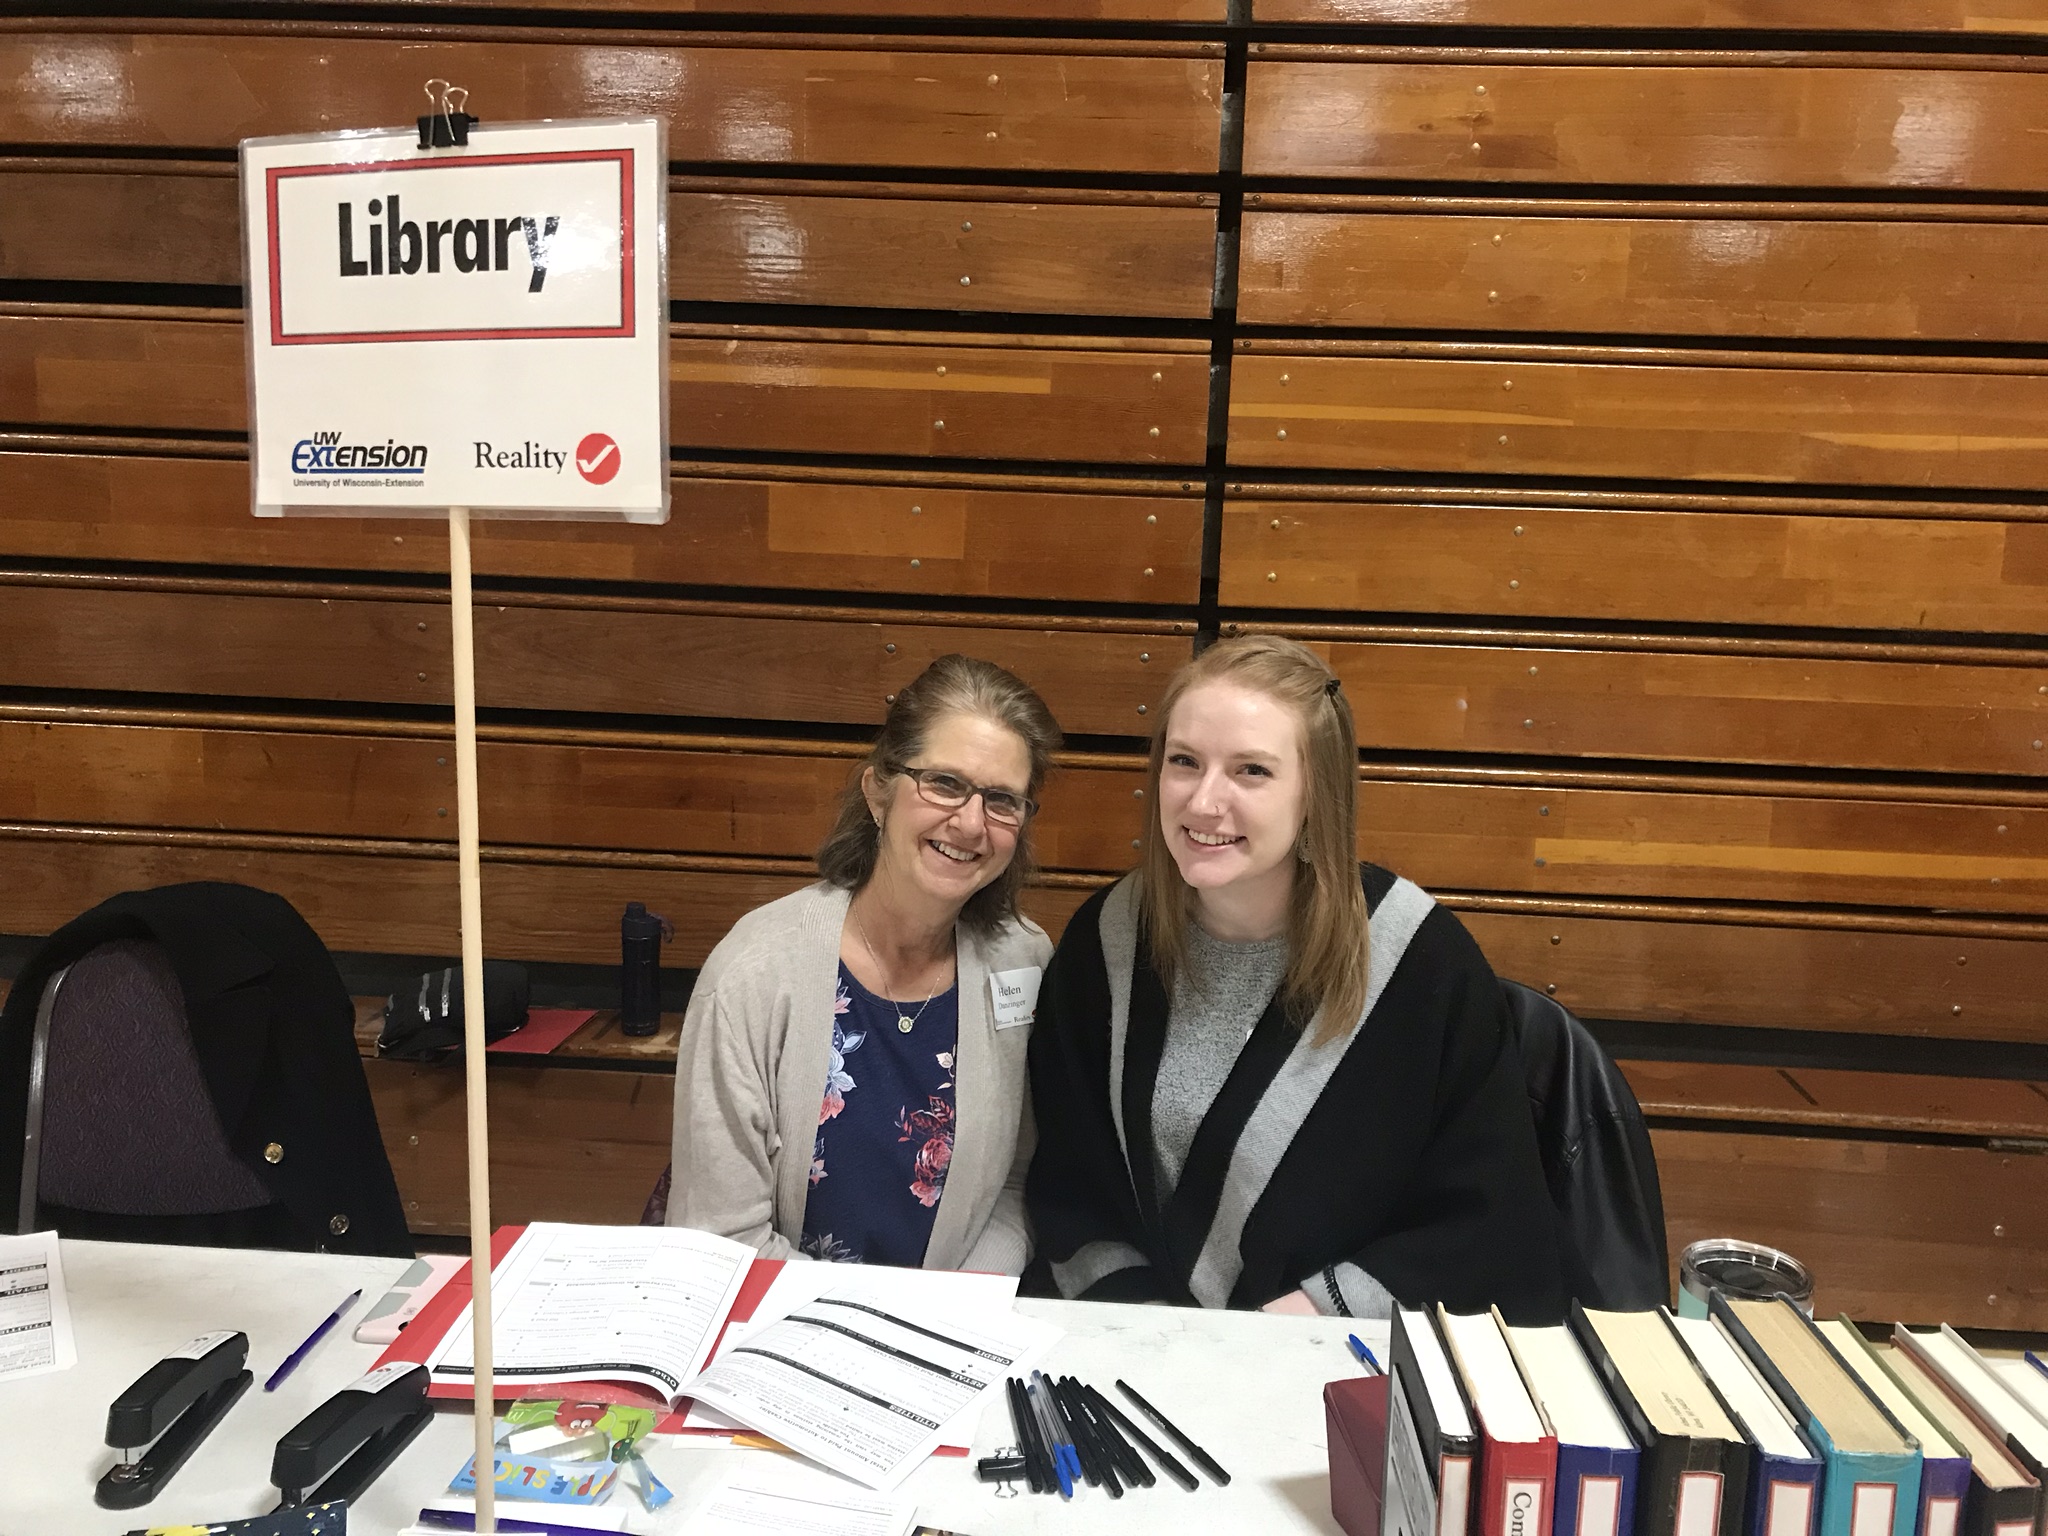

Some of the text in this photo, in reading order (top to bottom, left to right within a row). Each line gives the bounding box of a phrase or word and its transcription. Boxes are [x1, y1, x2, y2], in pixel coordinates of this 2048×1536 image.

[338, 194, 561, 293] Library
[313, 431, 342, 445] UW
[291, 439, 428, 474] Extension
[473, 442, 567, 474] Reality
[293, 479, 424, 488] University of Wisconsin-Extension
[998, 986, 1021, 997] Helen
[973, 1348, 1011, 1365] CREDIT
[650, 1368, 677, 1388] Other
[948, 1371, 984, 1388] RETAIL
[887, 1404, 938, 1428] UTILITIES
